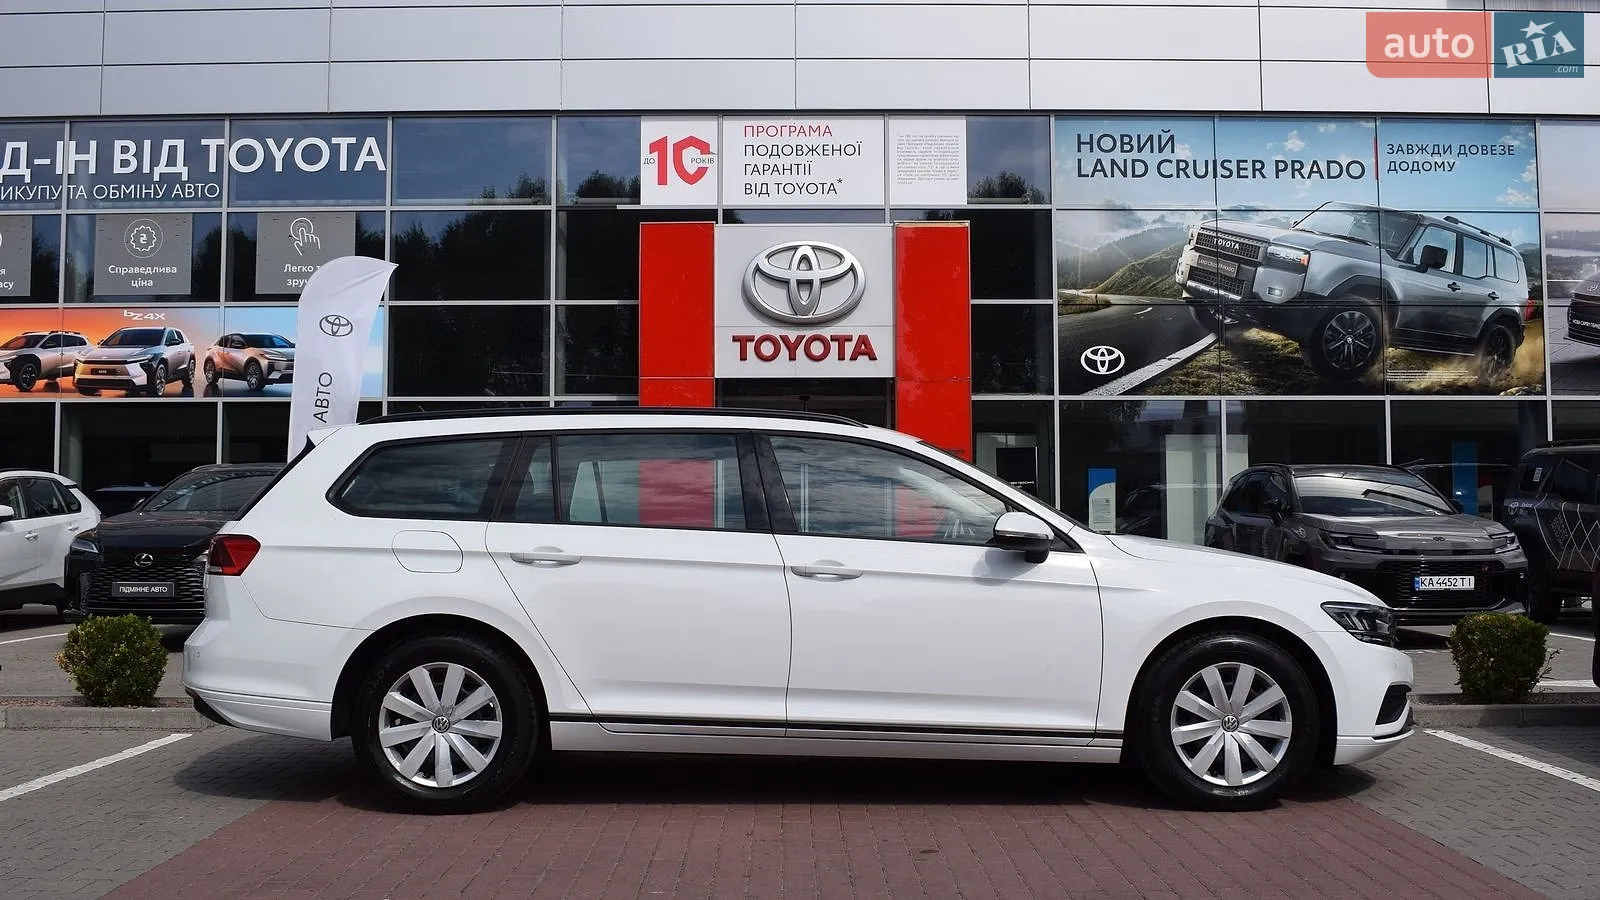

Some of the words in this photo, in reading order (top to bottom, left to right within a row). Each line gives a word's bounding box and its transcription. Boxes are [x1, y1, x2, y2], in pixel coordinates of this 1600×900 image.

[744, 125, 833, 137] ПРОГРАМА
[1077, 129, 1175, 154] НОВИЙ
[744, 141, 863, 159] ПОДОВЖЕНОЇ
[1386, 144, 1453, 157] ЗАВЖДИ
[1457, 144, 1515, 157] ДОВЕЗЕ
[113, 139, 188, 181] ВІД
[201, 137, 386, 173] TOYOTA
[744, 160, 813, 175] ГАРАНТІЇ
[1077, 158, 1149, 178] LAND
[1156, 159, 1267, 179] CRUISER
[1274, 159, 1366, 180] PRADO
[1387, 161, 1456, 174] ДОДОМУ
[68, 185, 87, 199] ТА
[93, 184, 167, 199] ОБМІНУ
[171, 183, 220, 198] АВТО
[744, 182, 770, 197] ВІД
[1213, 239, 1239, 250] TOYOTA
[108, 265, 177, 275] Справедлива
[284, 264, 314, 272] Легко
[131, 278, 153, 287] ціна
[732, 333, 878, 362] TOYOTA
[313, 372, 332, 423] АВТО
[1436, 578, 1458, 587] 4452
